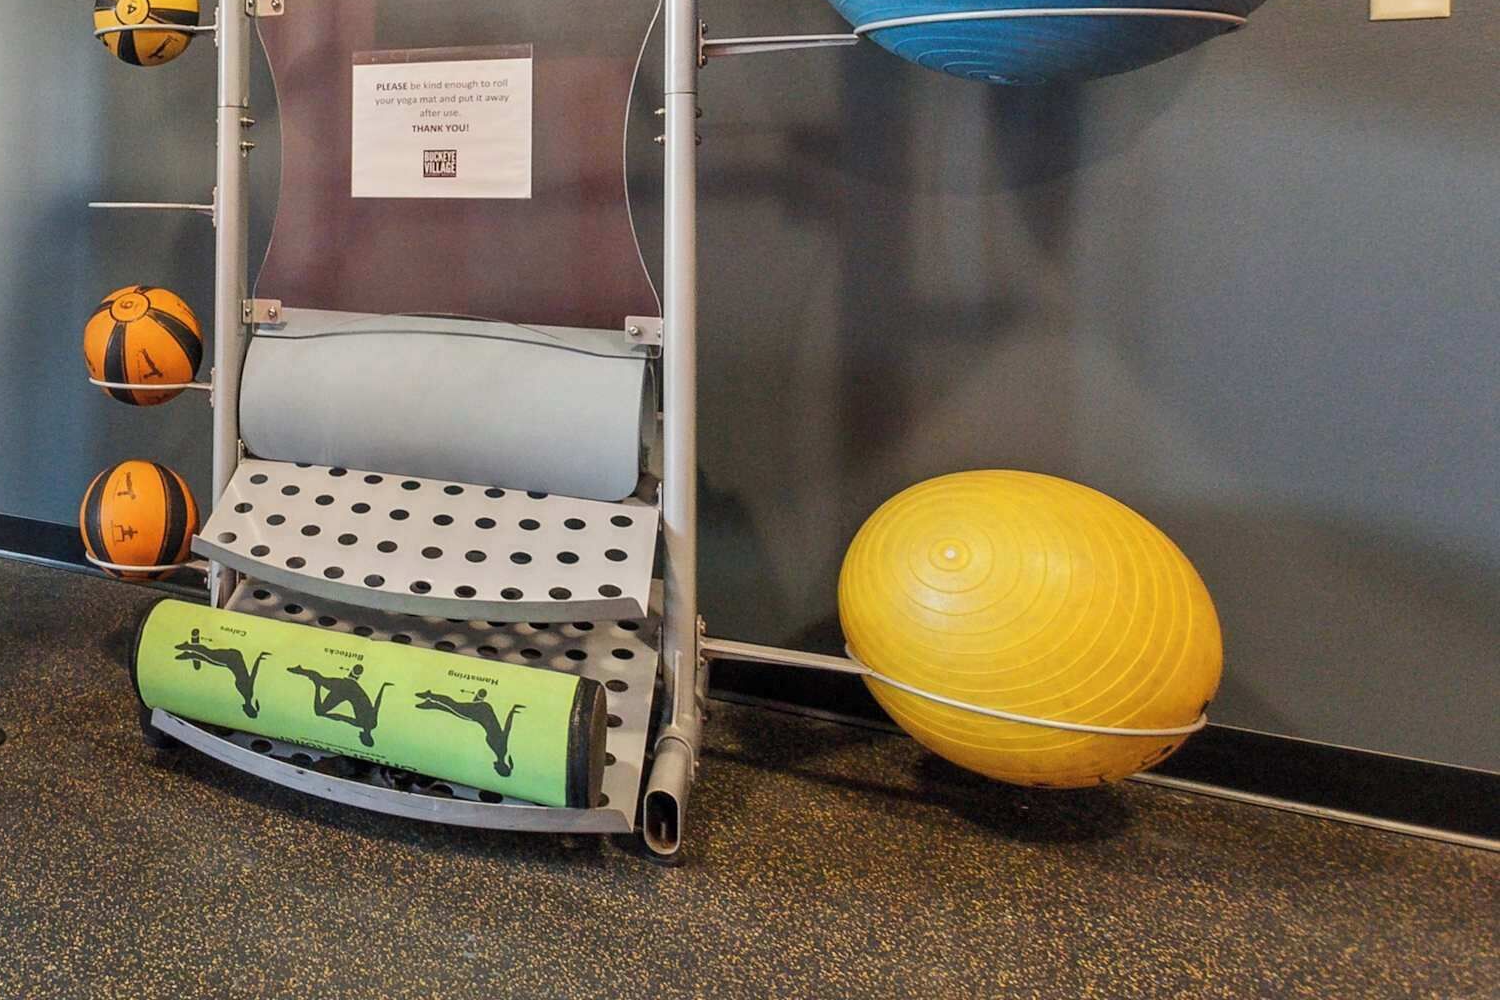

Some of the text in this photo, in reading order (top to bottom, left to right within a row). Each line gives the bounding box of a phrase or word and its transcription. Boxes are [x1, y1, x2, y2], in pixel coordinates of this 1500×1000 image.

[376, 78, 508, 91] PLEASE be kind enough to roll
[375, 97, 394, 106] your
[396, 96, 417, 106] yoga
[419, 95, 437, 103] mat
[439, 94, 456, 103] and
[459, 95, 474, 104] put
[485, 94, 510, 103] away
[419, 108, 441, 117] after
[412, 123, 469, 133] THANK YOU!
[424, 161, 457, 174] VILLAGE
[323, 647, 365, 661] Buttocks
[447, 669, 500, 686] Hamstring
